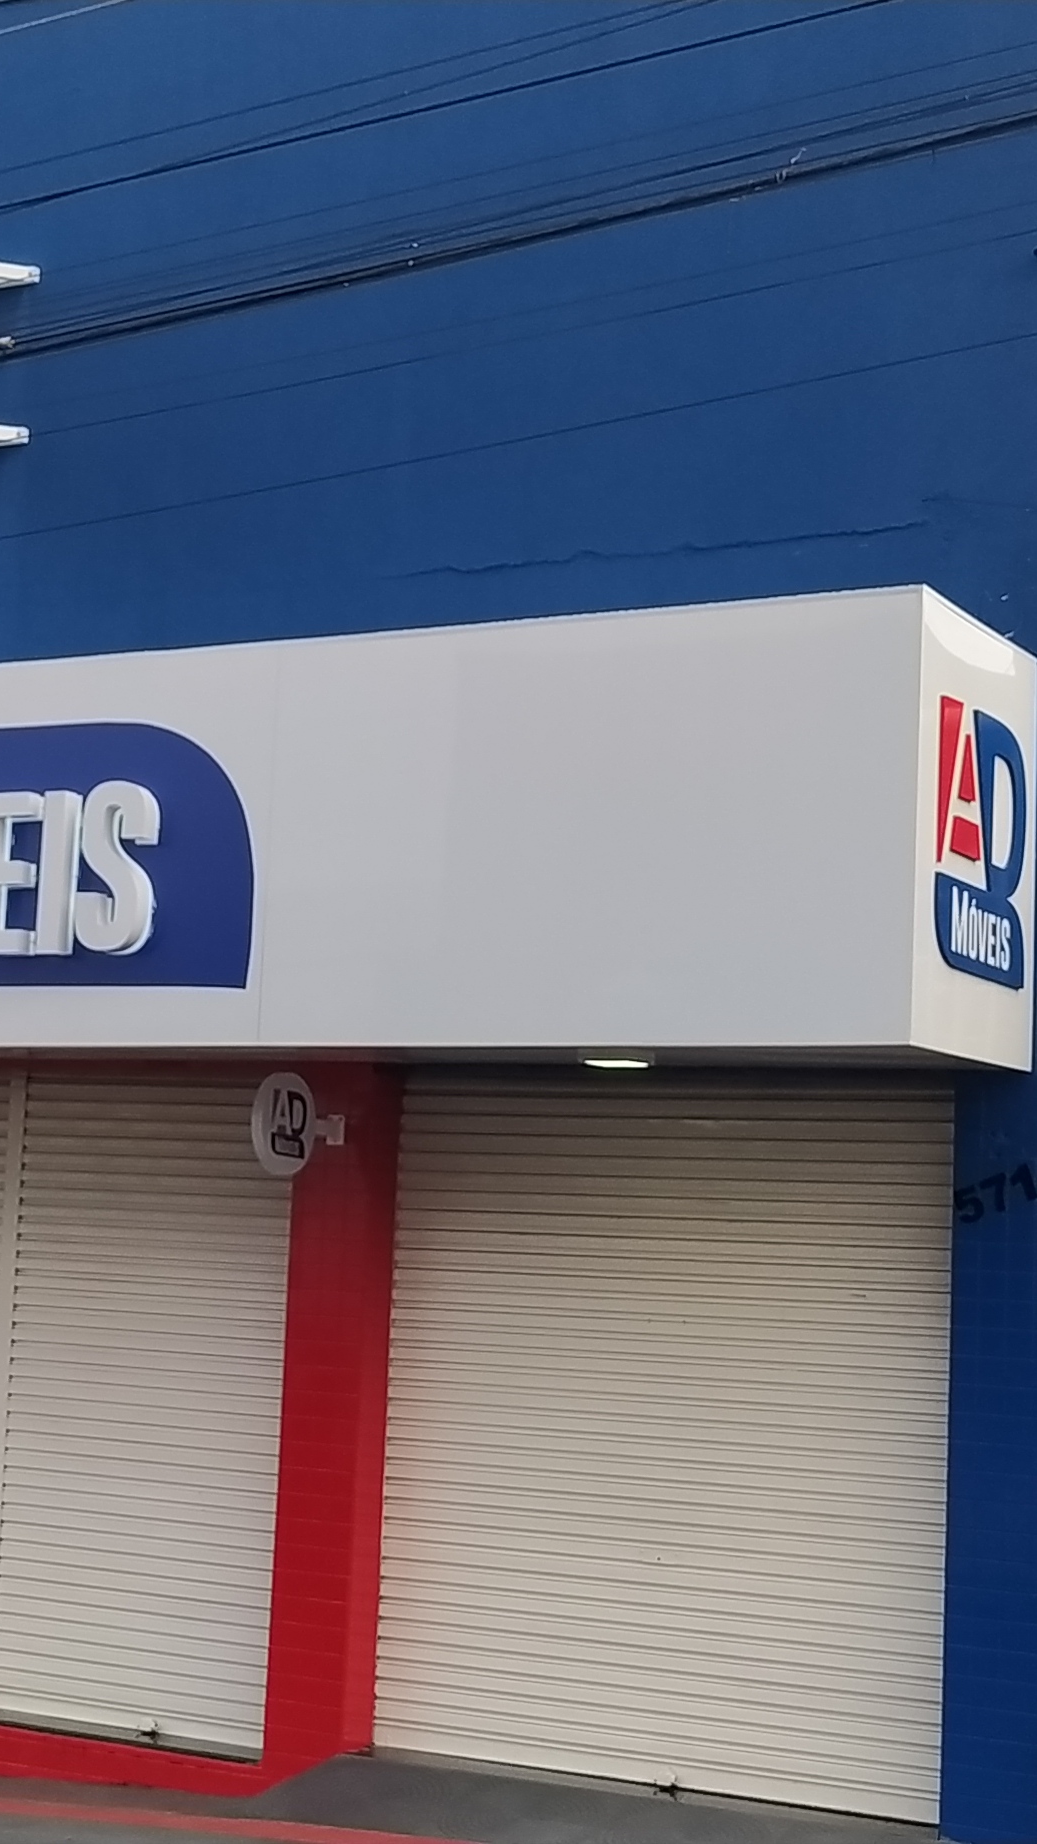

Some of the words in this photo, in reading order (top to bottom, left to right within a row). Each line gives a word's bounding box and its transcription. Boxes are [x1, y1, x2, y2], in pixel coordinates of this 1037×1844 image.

[935, 694, 1027, 893] AD
[951, 885, 1012, 972] MÓVEIS
[270, 1088, 308, 1136] AD
[954, 1163, 1037, 1224] 571
